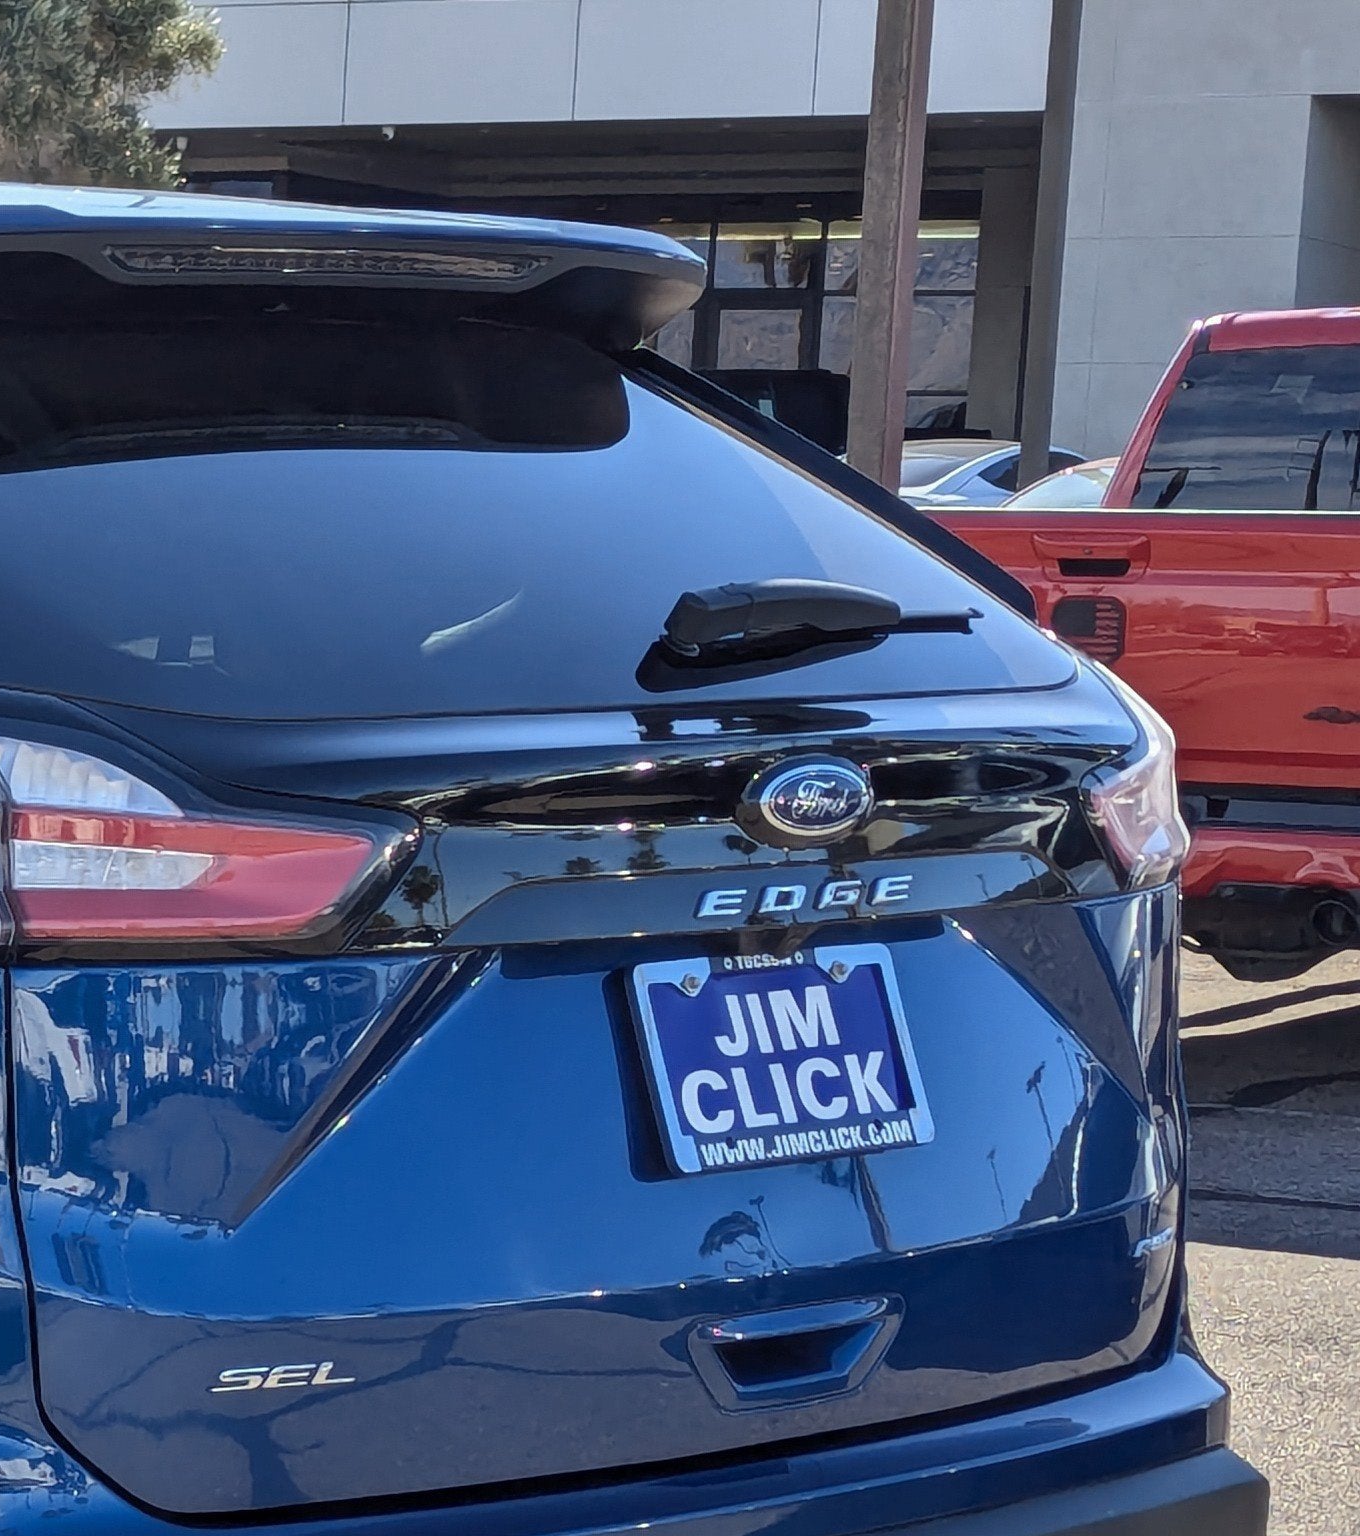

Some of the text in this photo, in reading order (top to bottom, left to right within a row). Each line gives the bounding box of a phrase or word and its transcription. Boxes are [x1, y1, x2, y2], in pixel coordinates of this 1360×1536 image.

[790, 780, 860, 819] Ford
[695, 874, 914, 919] EDGE
[714, 984, 841, 1057] JIM
[680, 1050, 898, 1134] CLICK
[699, 1118, 914, 1167] WWW.JIMCLICK.COM
[208, 1361, 356, 1394] SEL
